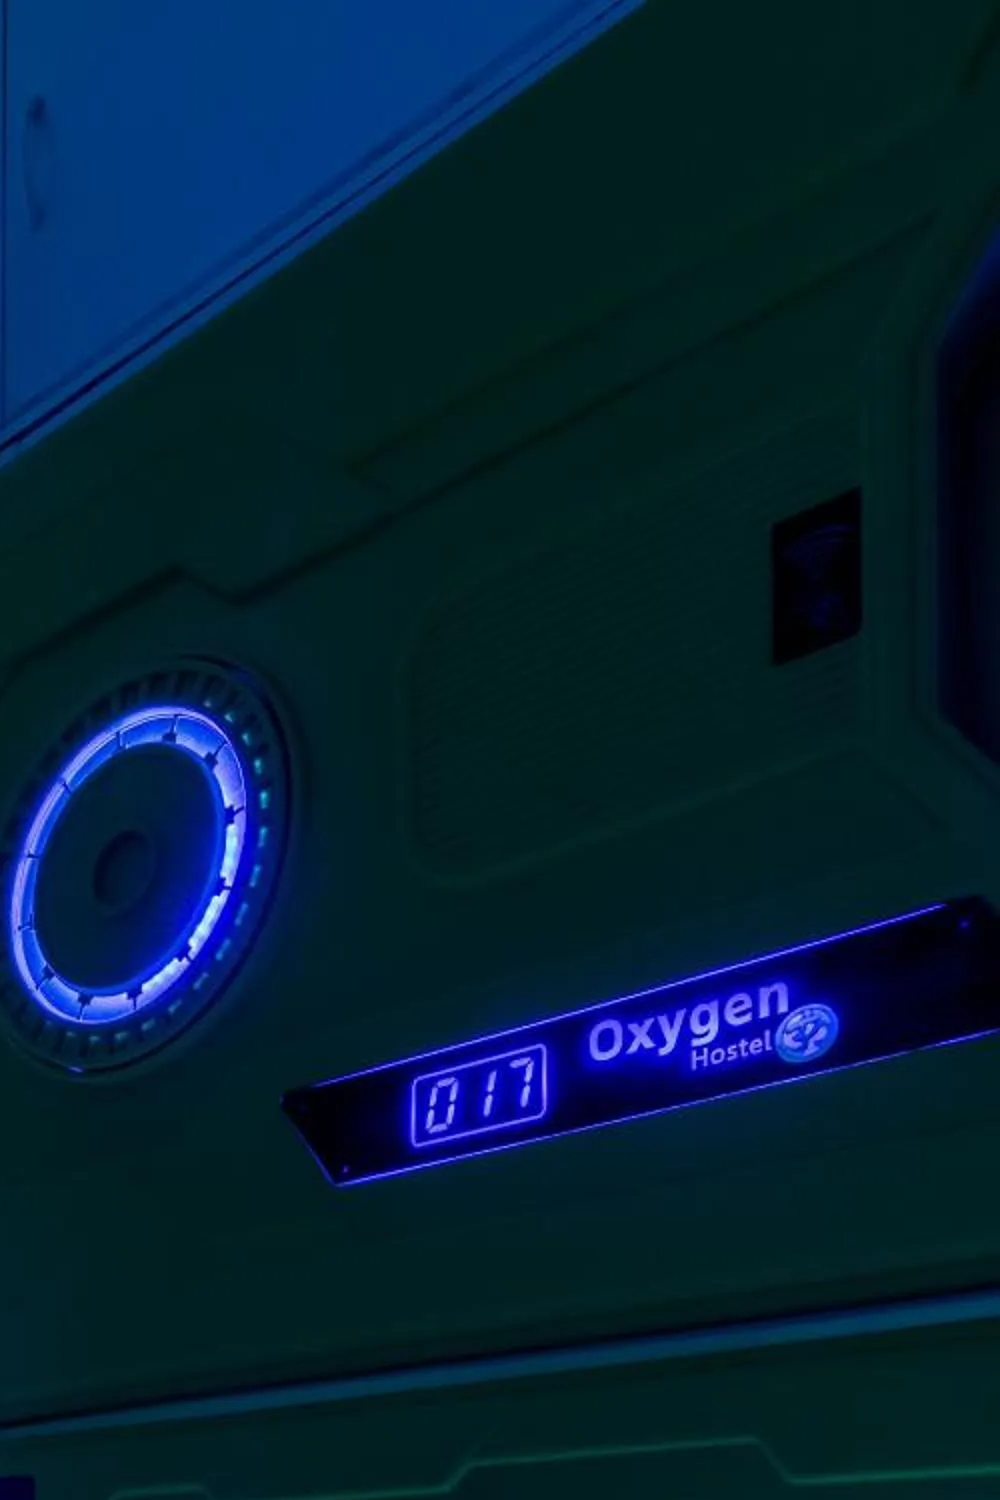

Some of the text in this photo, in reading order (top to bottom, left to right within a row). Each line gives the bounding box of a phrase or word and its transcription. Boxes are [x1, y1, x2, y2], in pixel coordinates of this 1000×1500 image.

[426, 981, 789, 1134] 017 Oxygen
[691, 1030, 772, 1072] Hostel
